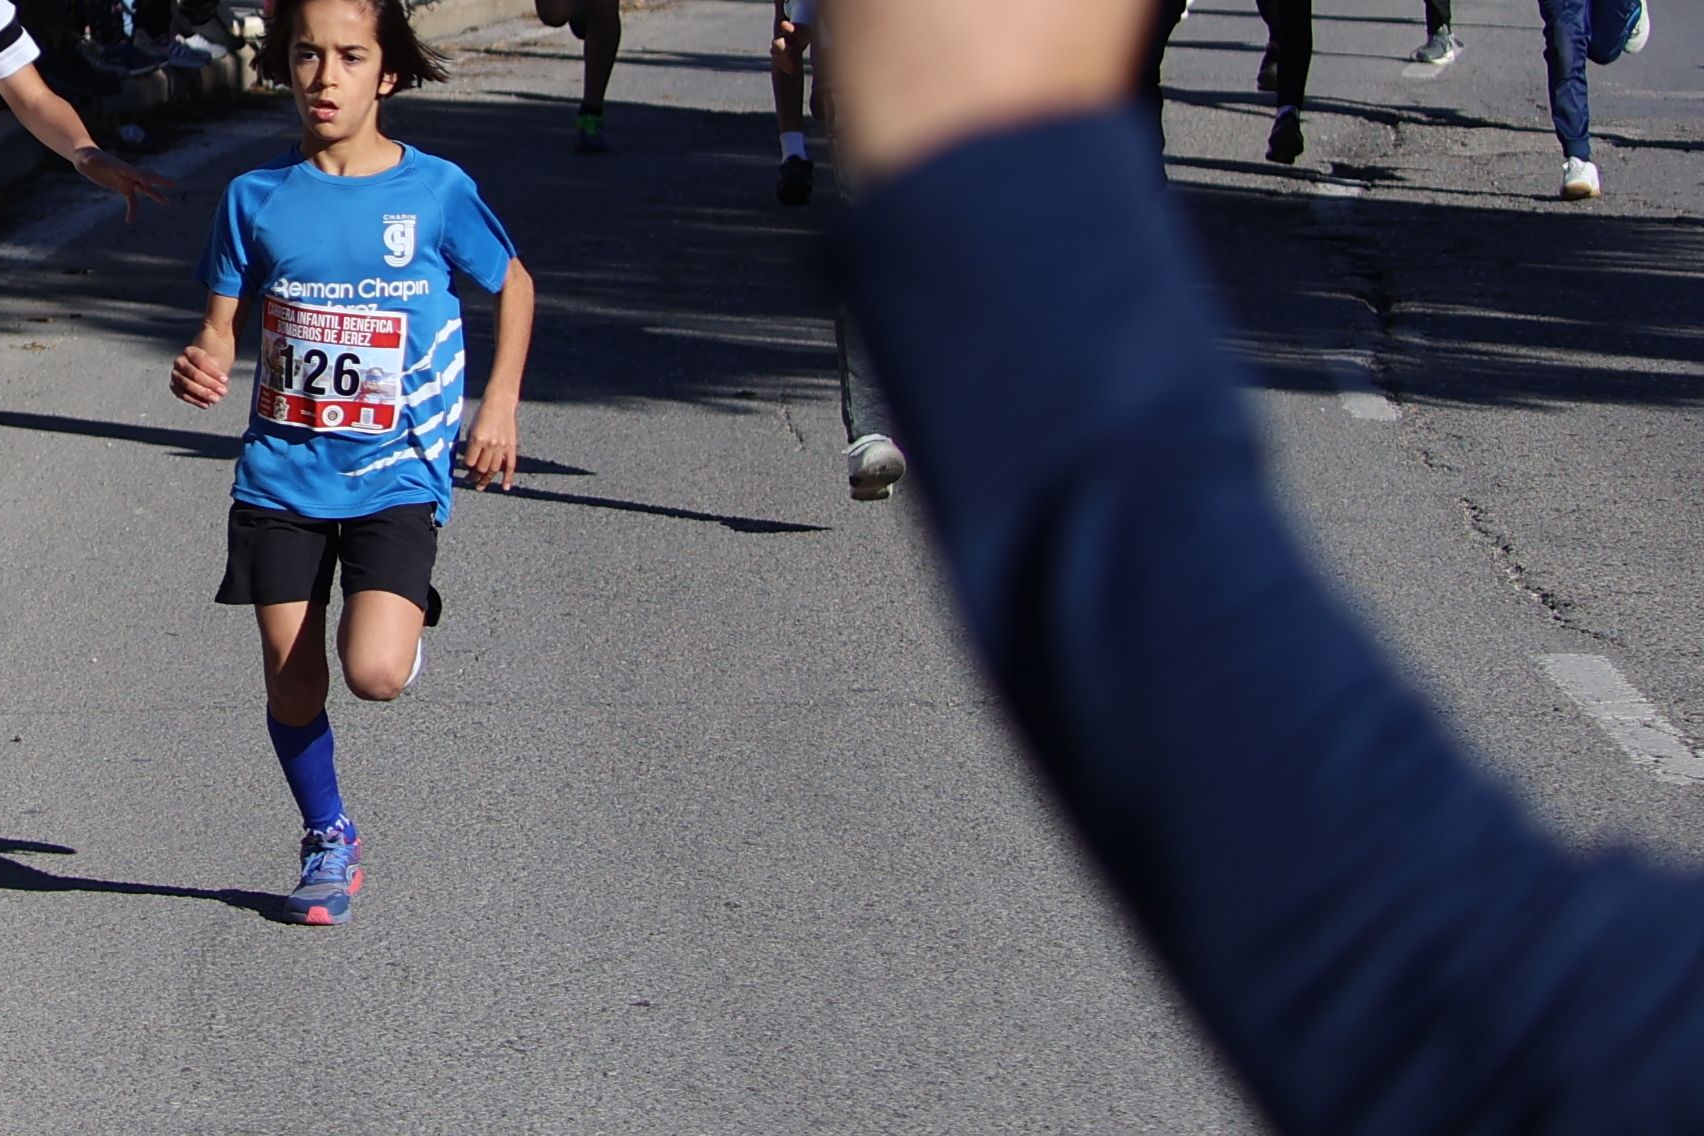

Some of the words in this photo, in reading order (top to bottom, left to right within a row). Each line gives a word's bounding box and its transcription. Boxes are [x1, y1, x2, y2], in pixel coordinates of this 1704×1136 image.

[358, 277, 429, 301] Chapin
[297, 311, 341, 330] INFANTIL
[343, 315, 393, 334] BENÉFICA
[324, 329, 338, 343] DE
[339, 330, 372, 346] JEREZ
[279, 344, 361, 397] 126
